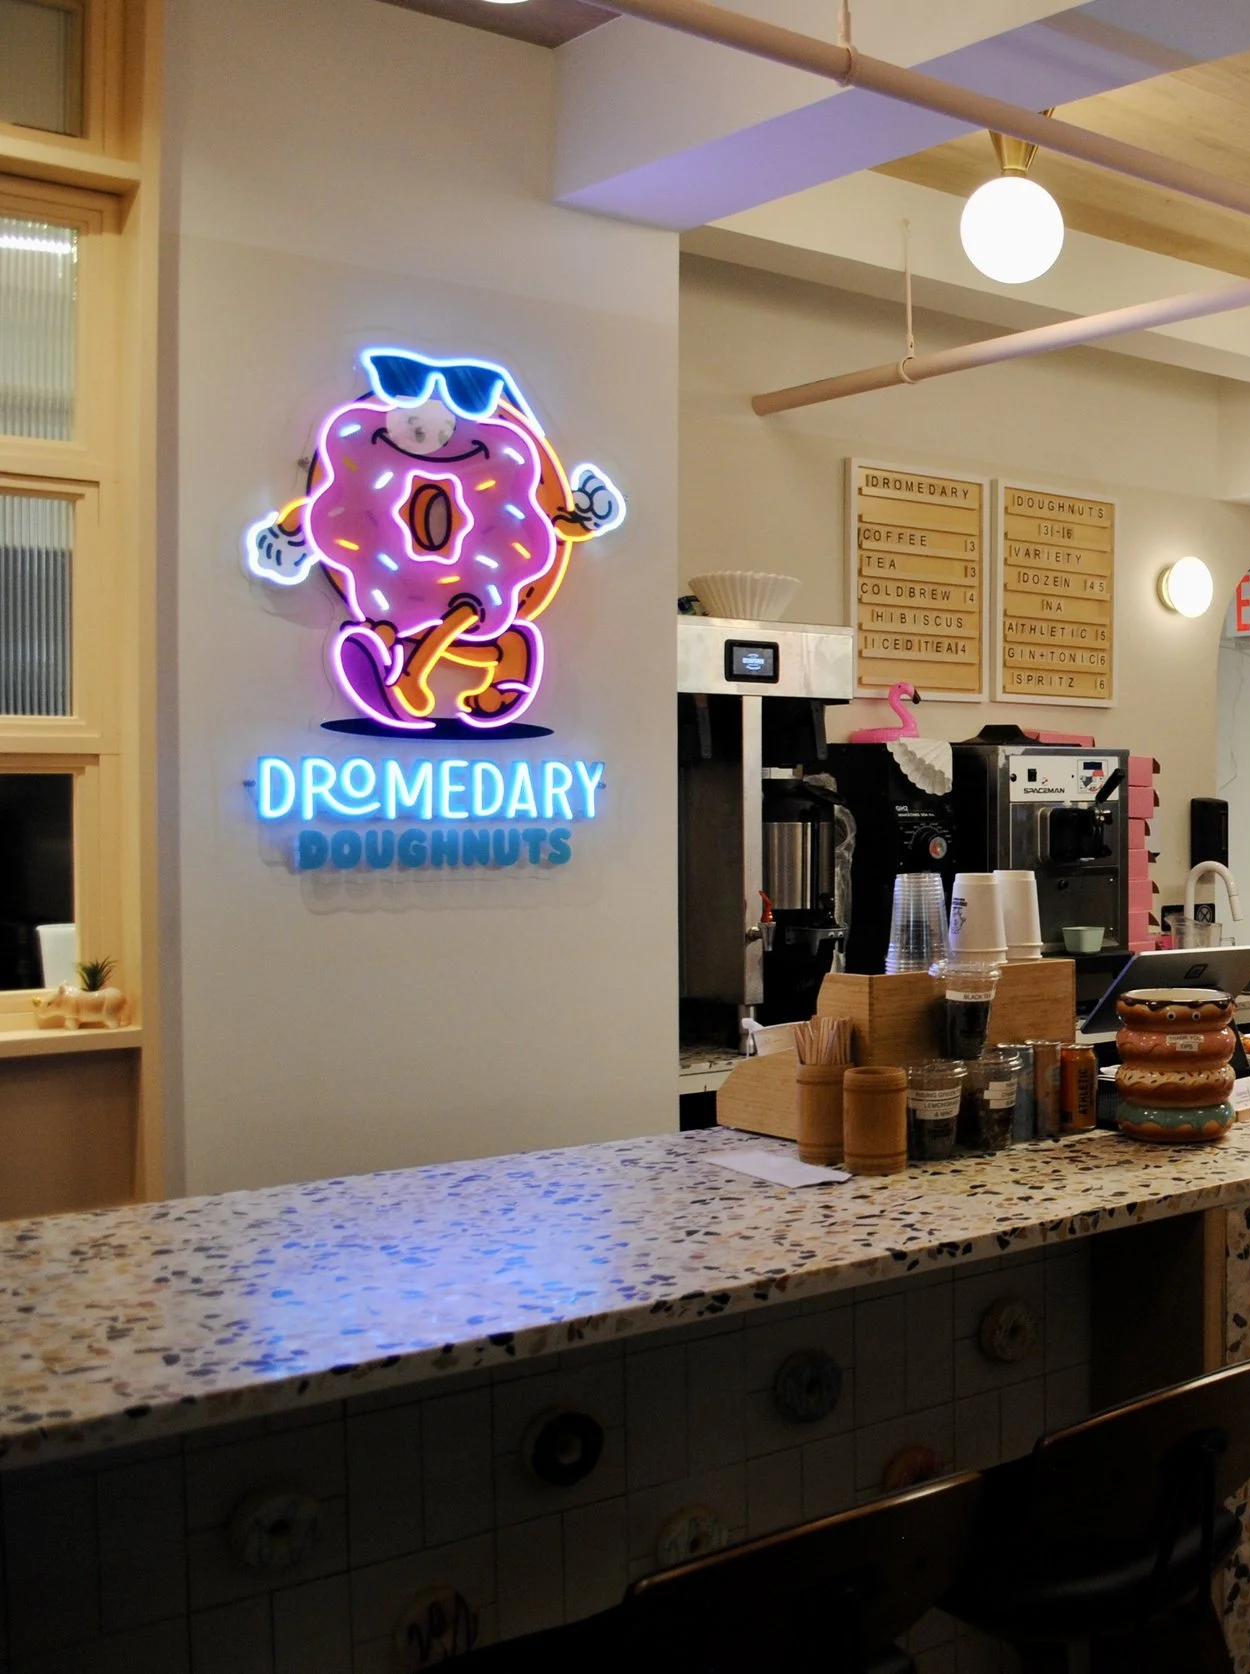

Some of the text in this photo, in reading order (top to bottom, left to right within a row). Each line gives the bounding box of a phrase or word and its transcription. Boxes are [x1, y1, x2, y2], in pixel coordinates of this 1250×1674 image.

[870, 475, 970, 500] DROMEDARY
[1016, 495, 1104, 519] DOUGHNUTS
[862, 528, 927, 547] COFFEE
[865, 555, 897, 570] TEA
[1014, 546, 1082, 564] VARIETY
[1022, 572, 1071, 588] DOZEN
[1045, 600, 1063, 613] NA
[875, 611, 964, 629] HIBISCUS
[1007, 622, 1088, 640] ATHLETIC
[1015, 673, 1076, 688] SPRITZ
[257, 756, 605, 821] DROMEDARY
[1023, 787, 1065, 795] SPACEMAN
[297, 827, 572, 871] DOUGHNUTS
[1078, 1067, 1089, 1116] ATHLETIC
